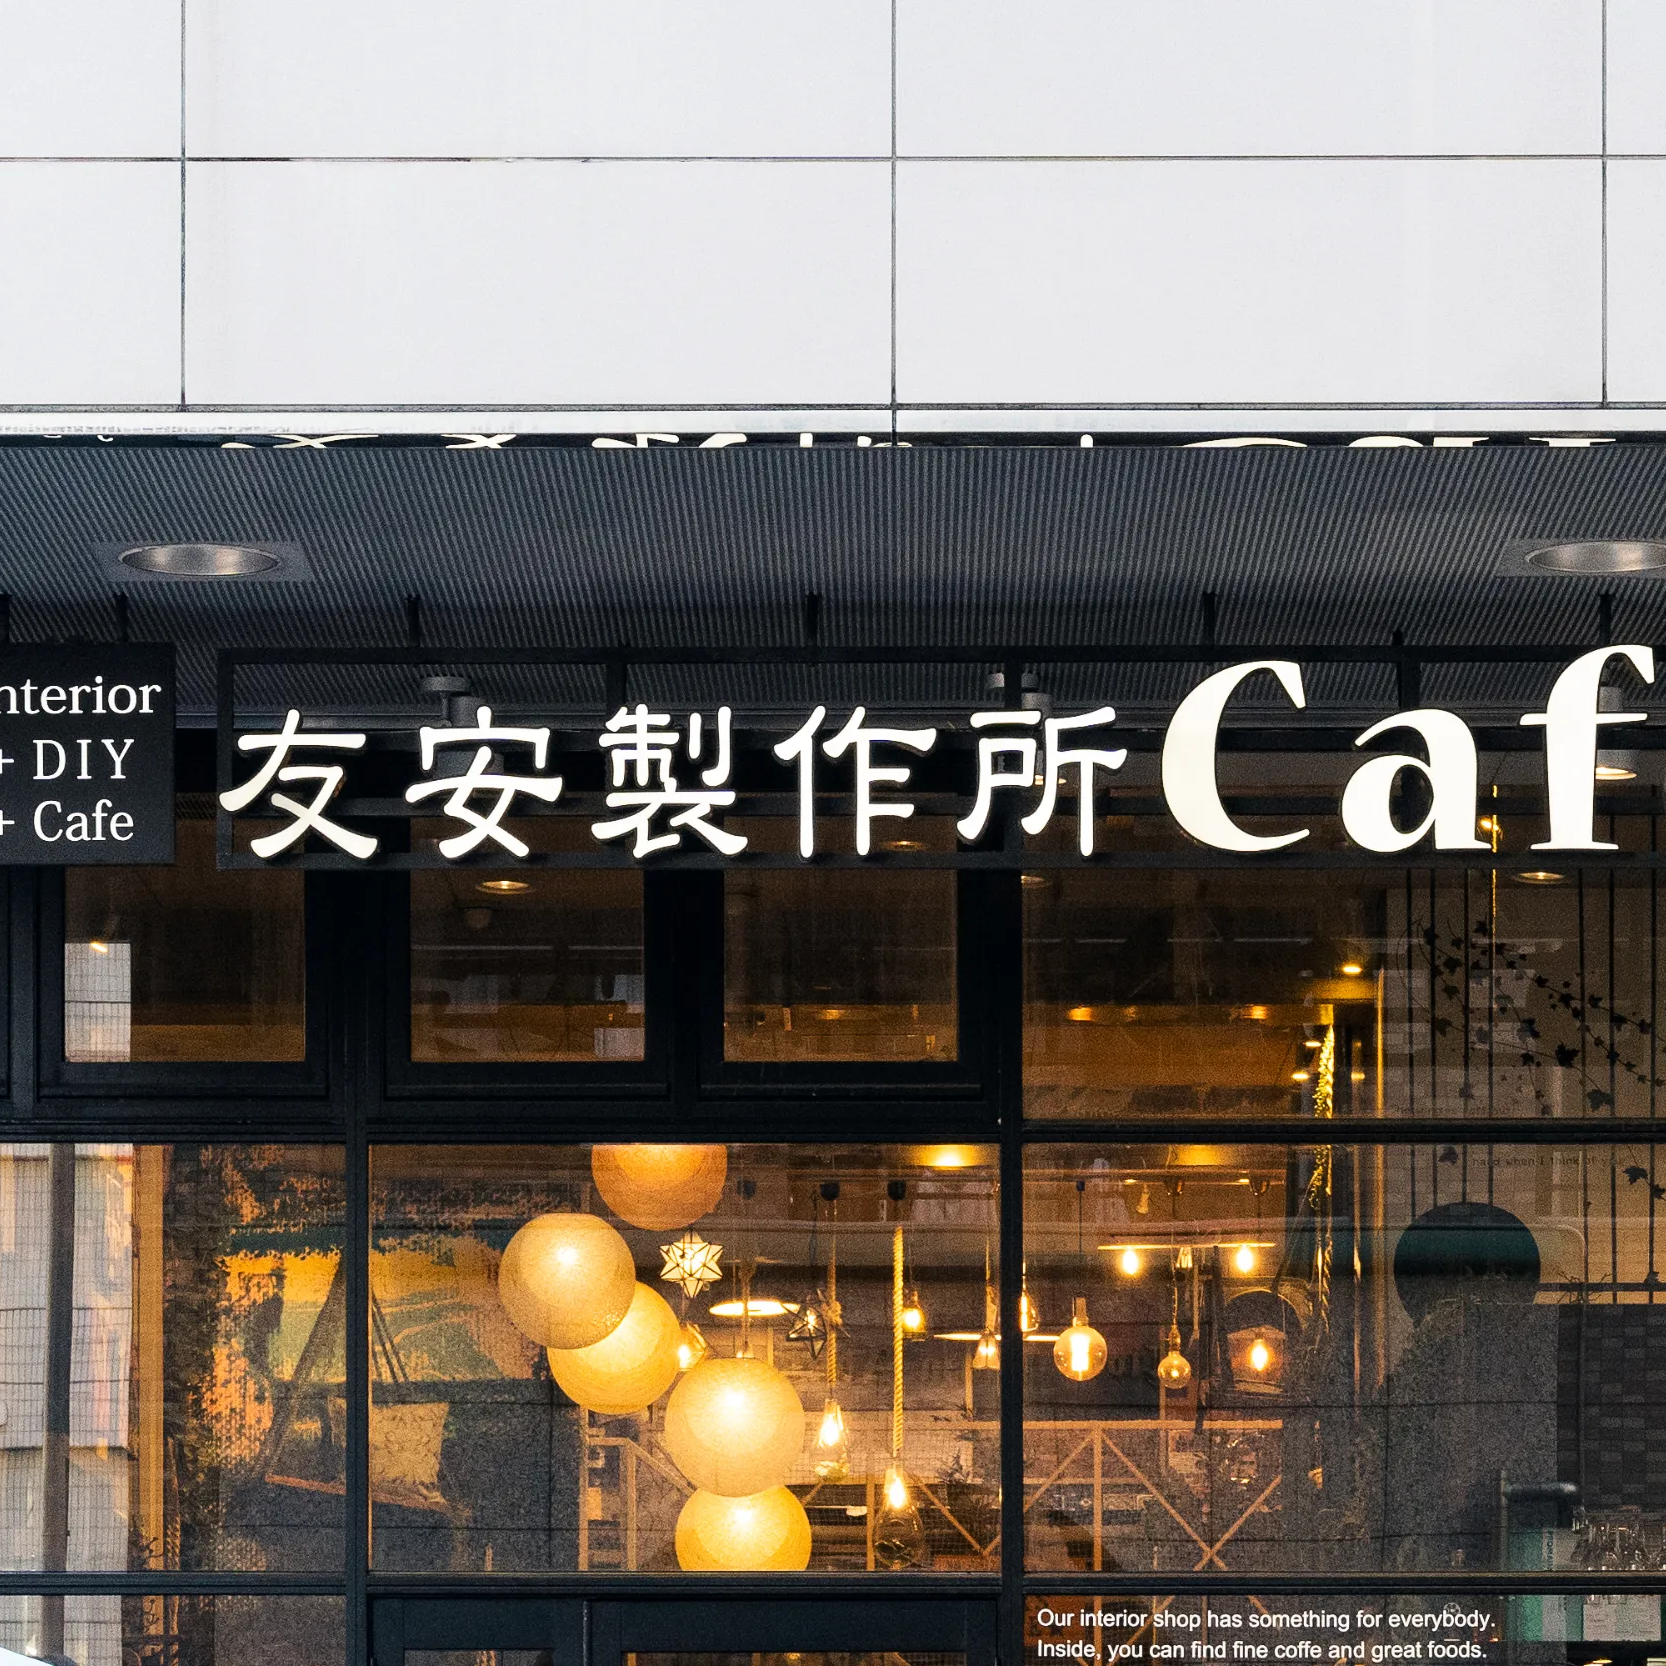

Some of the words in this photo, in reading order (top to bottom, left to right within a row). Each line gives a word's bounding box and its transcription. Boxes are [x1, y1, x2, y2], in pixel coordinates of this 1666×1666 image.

[33, 739, 134, 779] DIY
[220, 703, 1127, 860] 友安製作所
[34, 799, 134, 841] Cafe
[1038, 1609, 1074, 1626] Our
[1081, 1610, 1147, 1626] interior
[1154, 1610, 1200, 1631] shop
[1208, 1610, 1242, 1627] has
[1249, 1610, 1349, 1632] something
[1356, 1610, 1383, 1627] for
[1389, 1610, 1495, 1631] everybody.
[1038, 1640, 1100, 1660] Inside,
[1108, 1645, 1142, 1661] you
[1150, 1645, 1184, 1657] can
[1191, 1641, 1226, 1658] find
[1233, 1641, 1268, 1658] fine
[1275, 1641, 1321, 1658] coffe
[1329, 1642, 1364, 1658] and
[1372, 1642, 1422, 1662] great
[1428, 1639, 1487, 1657] foods.
